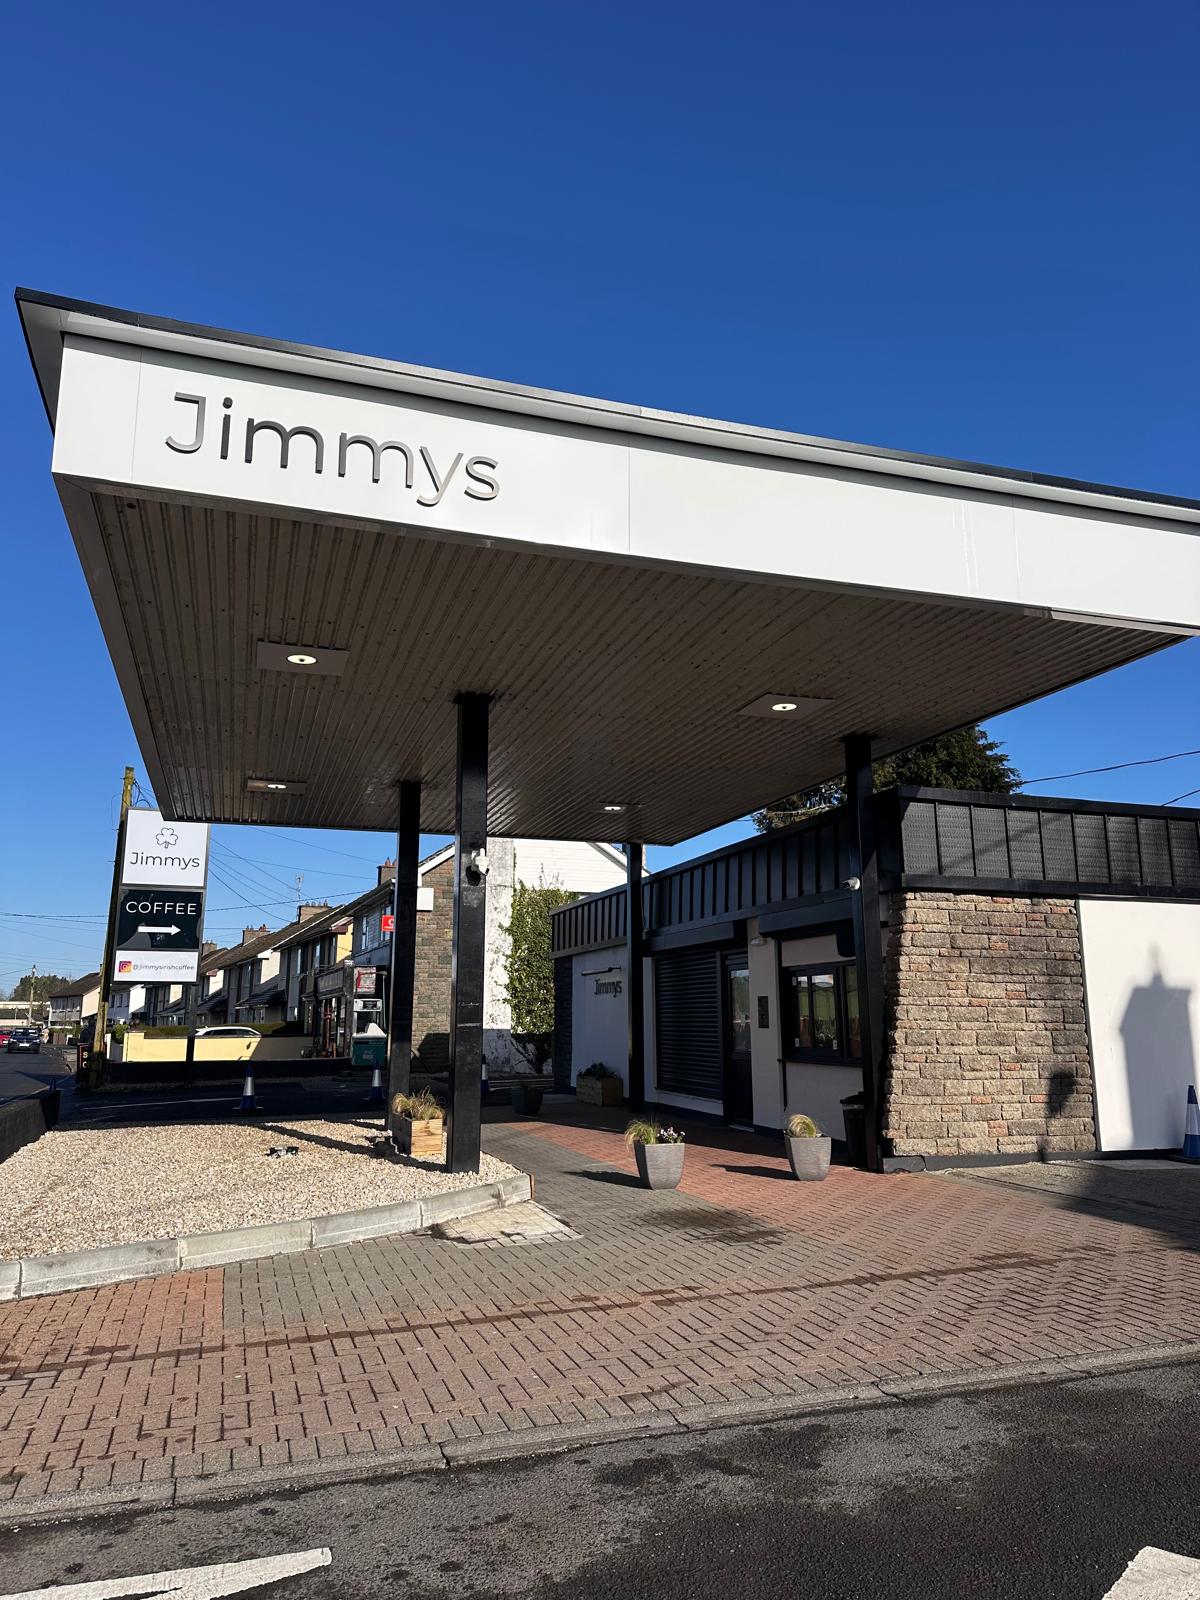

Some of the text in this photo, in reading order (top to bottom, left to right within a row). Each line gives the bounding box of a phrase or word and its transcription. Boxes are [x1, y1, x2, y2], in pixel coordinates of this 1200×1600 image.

[165, 392, 501, 508] Jimmys
[129, 851, 200, 870] Jimmys
[126, 901, 197, 915] COFFEE
[133, 963, 195, 971] @jimmysirishcoffee
[594, 978, 622, 998] Jimmys
